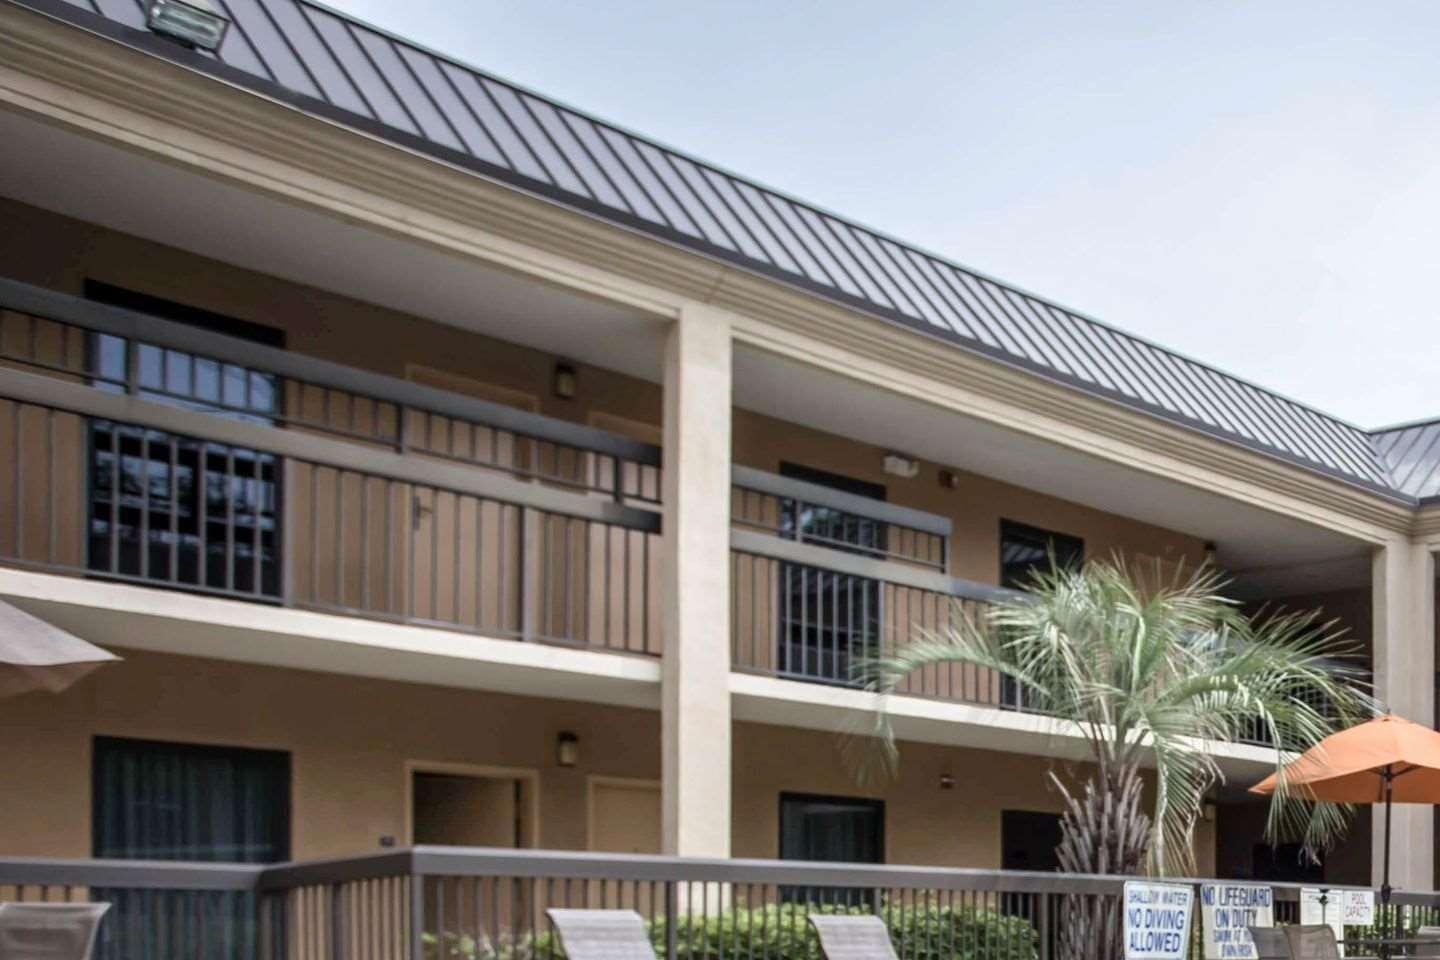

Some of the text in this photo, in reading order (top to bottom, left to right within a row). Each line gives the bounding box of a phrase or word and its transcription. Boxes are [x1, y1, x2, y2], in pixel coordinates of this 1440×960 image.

[1162, 890, 1188, 906] WATER
[1201, 886, 1271, 907] NO LIFEGUARD
[1127, 908, 1185, 930] NO DIVING
[1215, 908, 1257, 928] ON DUTY
[1128, 931, 1181, 952] ALLOWED
